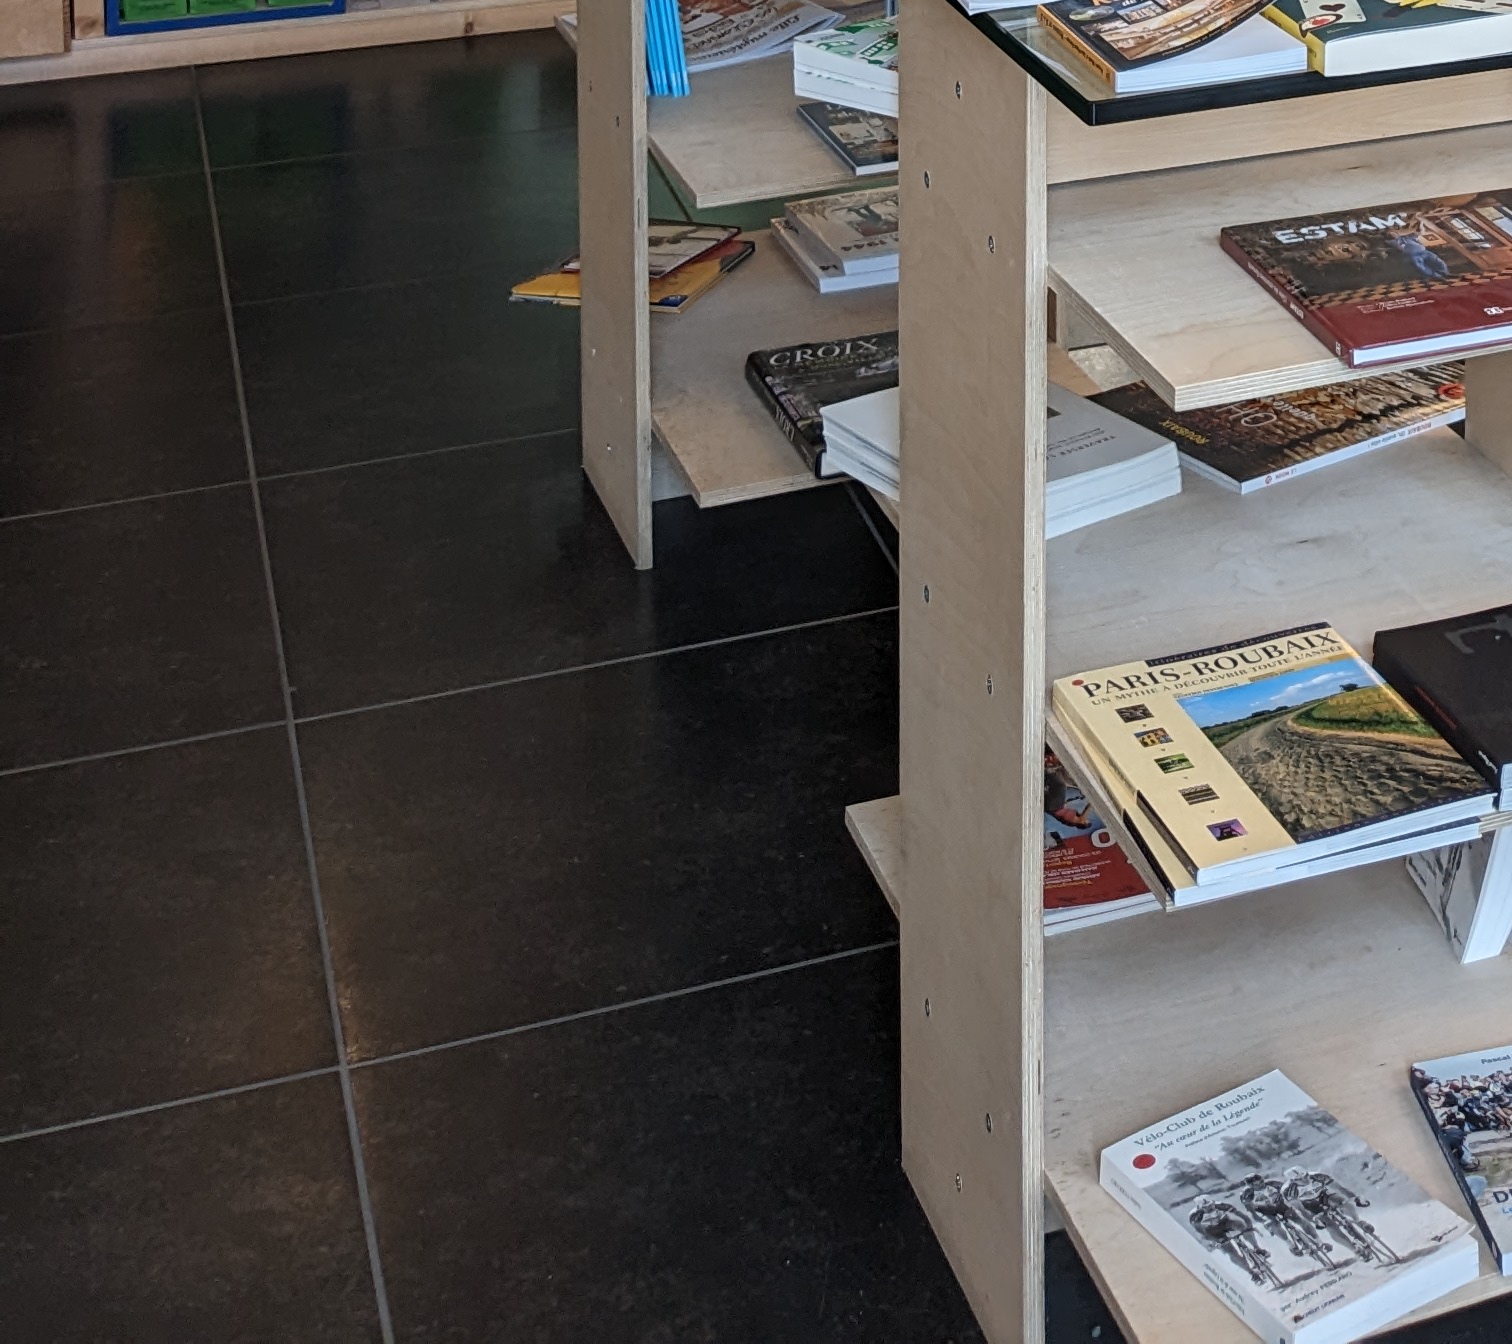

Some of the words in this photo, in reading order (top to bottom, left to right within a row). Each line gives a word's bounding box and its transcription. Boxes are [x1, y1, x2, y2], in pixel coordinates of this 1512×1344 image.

[769, 337, 879, 367] CROIX
[1081, 631, 1342, 700] PARIS-ROUBAIX
[1091, 696, 1112, 707] UN
[1115, 686, 1161, 702] MYTHE
[1174, 668, 1249, 692] DÉCOUVRIR
[1250, 657, 1290, 674] TOUTE
[1480, 1054, 1511, 1065] Pascal
[1134, 1115, 1197, 1147] Vélo-Club
[1198, 1108, 1214, 1120] de
[1214, 1085, 1266, 1112] Roubaix
[1199, 1122, 1211, 1133] de
[1211, 1117, 1223, 1128] la
